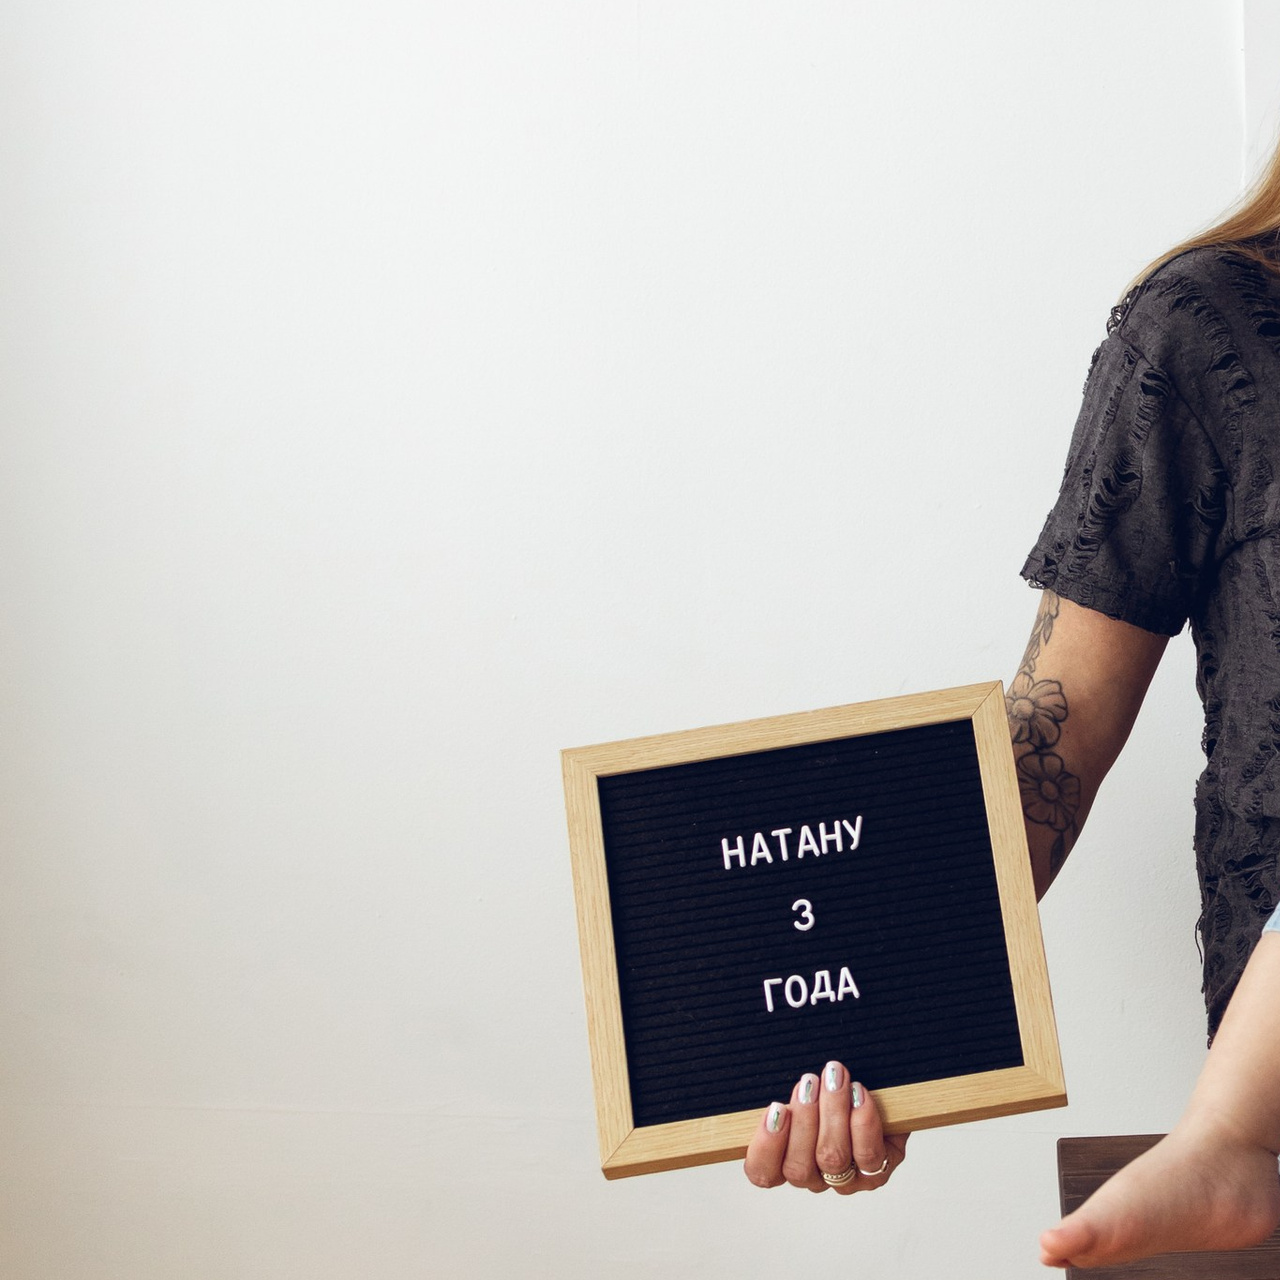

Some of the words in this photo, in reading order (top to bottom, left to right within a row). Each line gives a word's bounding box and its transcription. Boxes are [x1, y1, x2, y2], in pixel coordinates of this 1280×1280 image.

[721, 815, 863, 870] НАТАНУ
[791, 898, 816, 931] 3
[763, 966, 860, 1013] ГОДА
